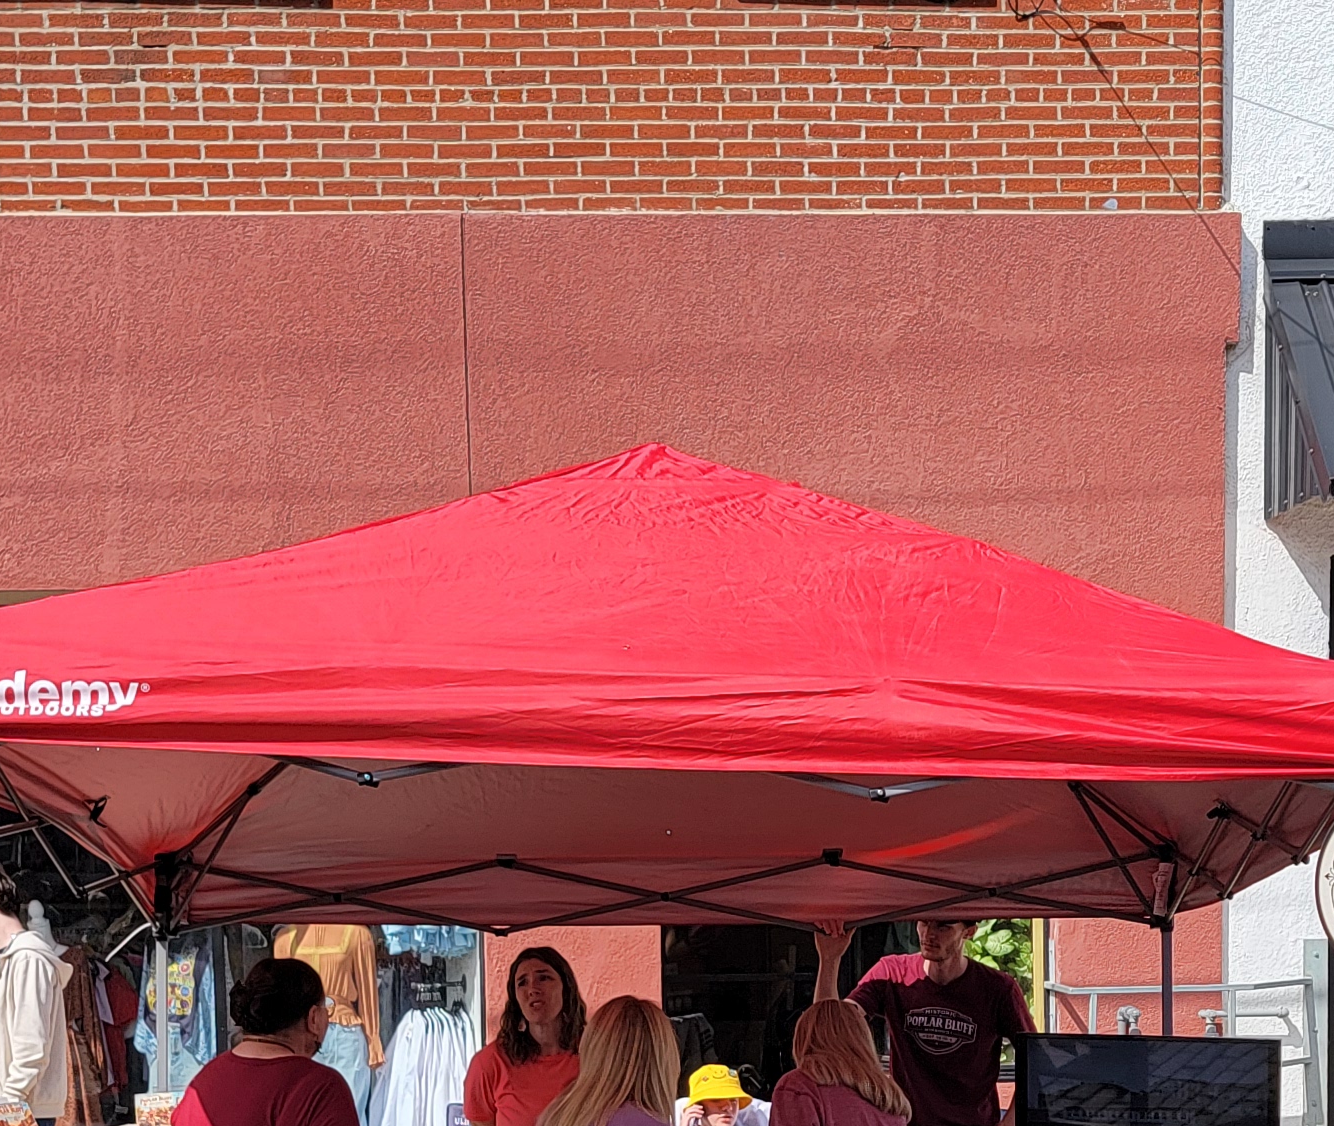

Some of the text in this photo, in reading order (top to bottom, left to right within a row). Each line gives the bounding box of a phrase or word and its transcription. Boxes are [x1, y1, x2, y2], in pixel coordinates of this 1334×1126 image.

[925, 1009, 957, 1018] HISTORIC
[907, 1016, 975, 1036] POPLAR BLUFF
